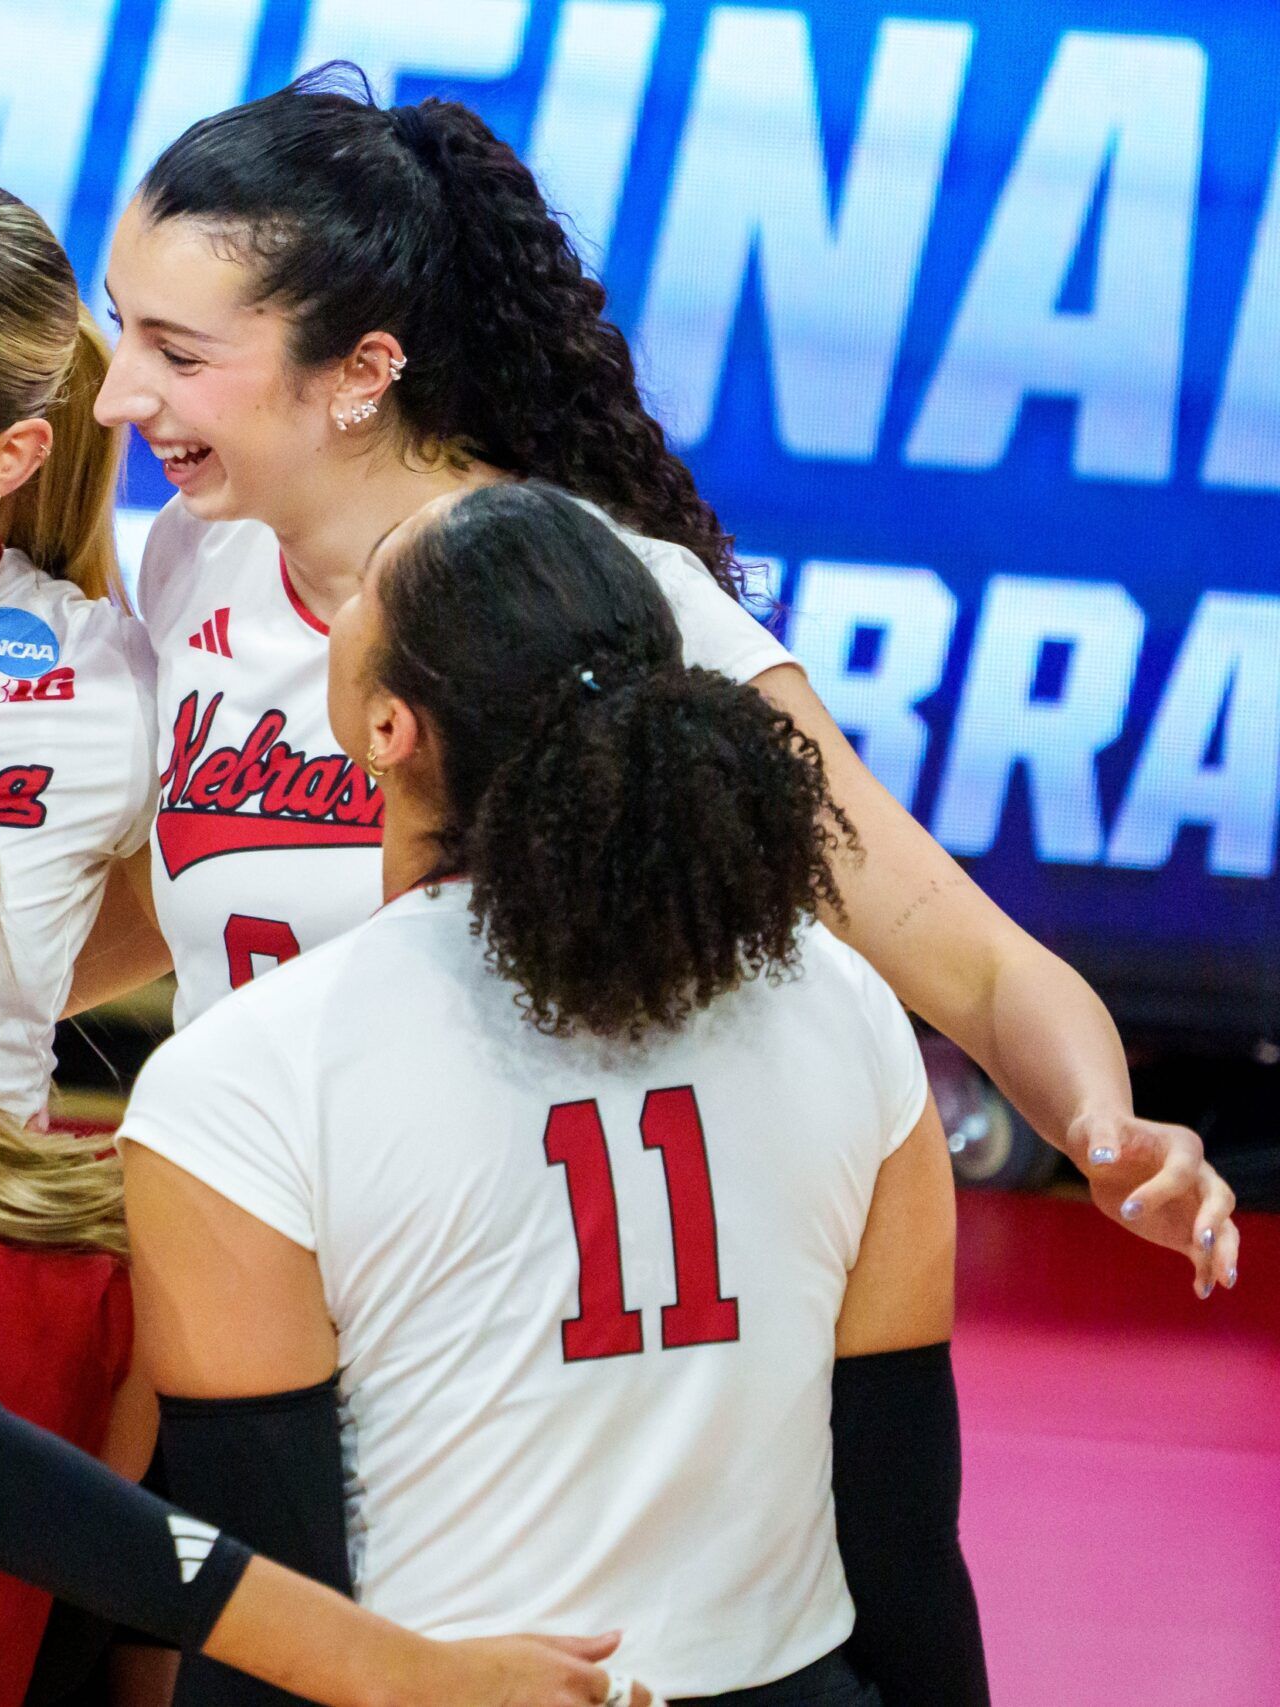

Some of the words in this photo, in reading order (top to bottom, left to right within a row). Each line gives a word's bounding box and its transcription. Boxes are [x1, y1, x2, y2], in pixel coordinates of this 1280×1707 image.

[160, 690, 386, 828] Nebras
[726, 555, 1280, 879] BRA
[542, 1084, 740, 1364] 11
